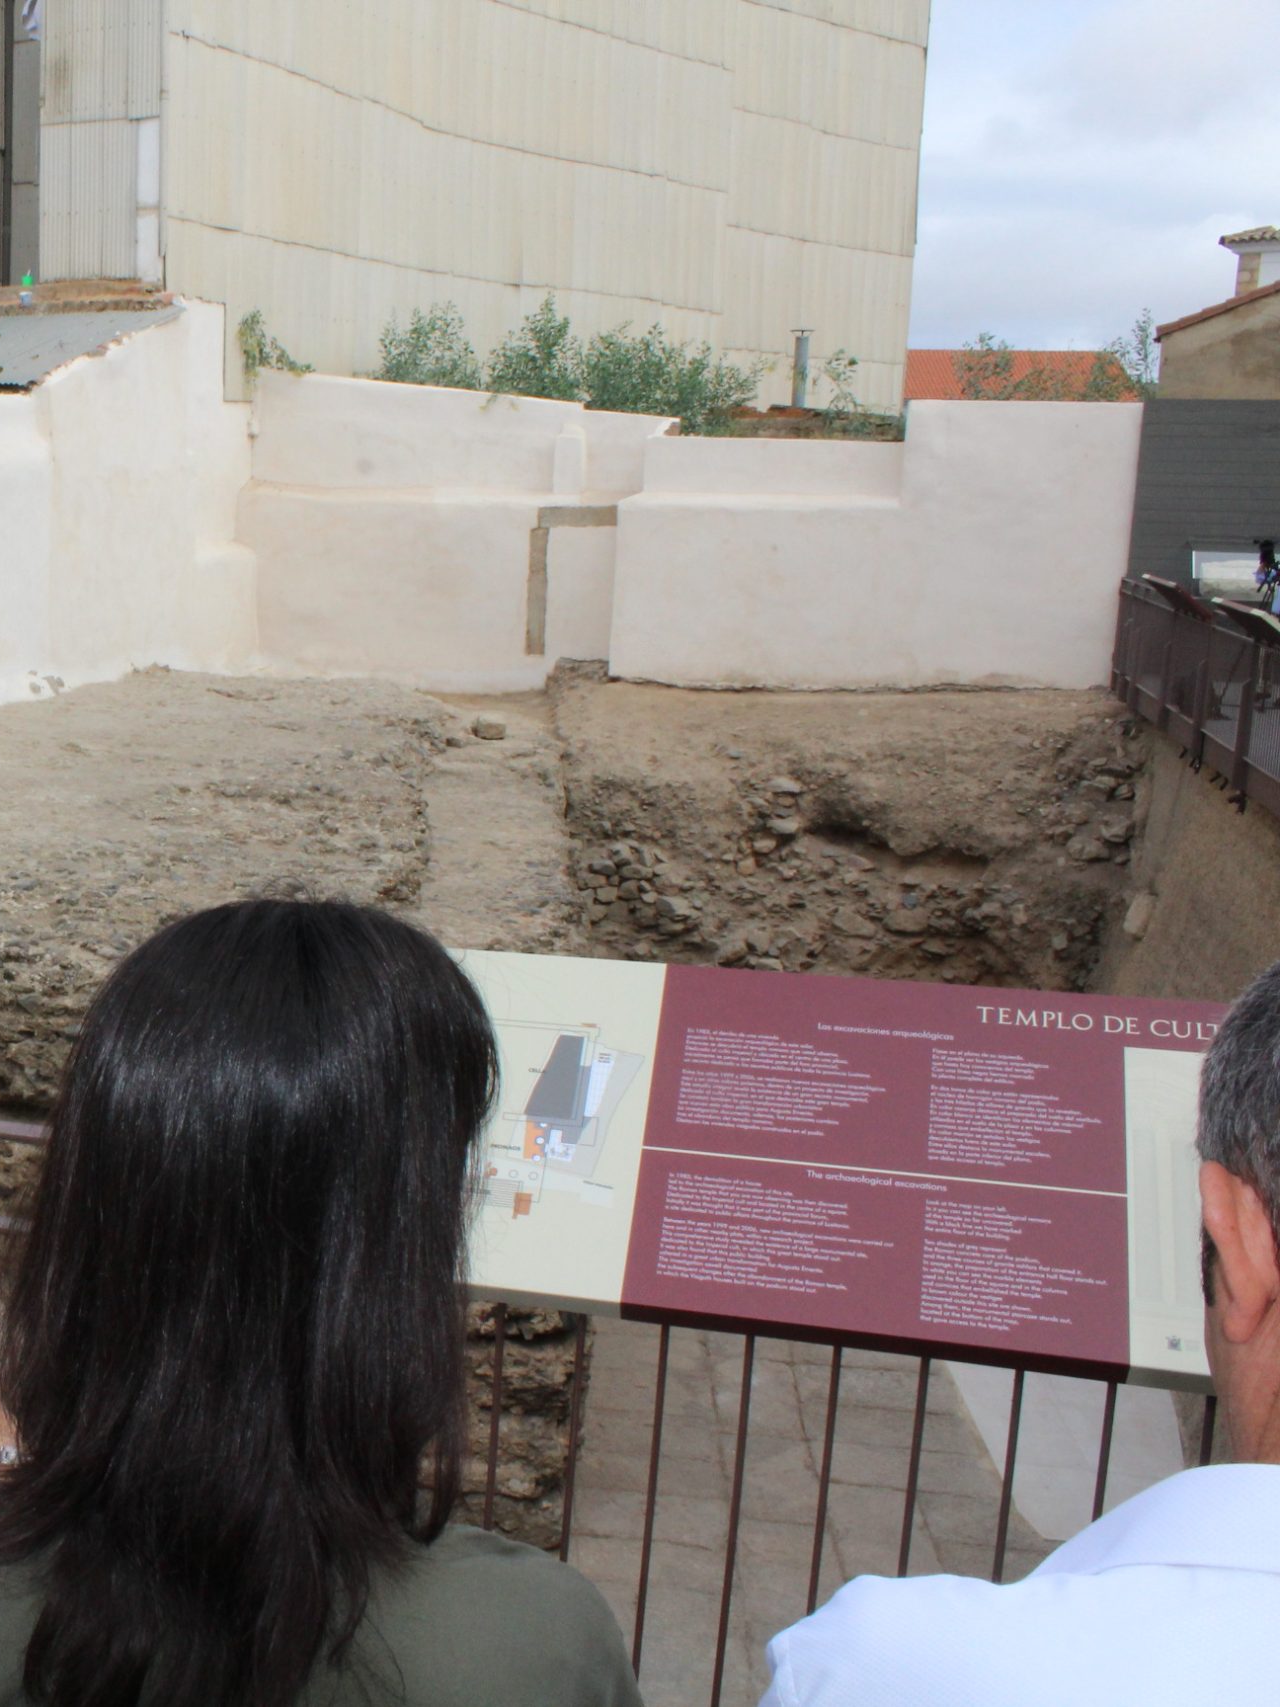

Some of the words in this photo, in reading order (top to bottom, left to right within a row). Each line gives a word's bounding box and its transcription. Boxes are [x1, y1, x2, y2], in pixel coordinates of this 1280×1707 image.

[818, 1022, 832, 1031] Las
[834, 1025, 890, 1036] excavaciones
[892, 1030, 954, 1041] arqueológicas
[976, 1006, 1093, 1030] TEMPLO
[1104, 1015, 1140, 1035] DE
[806, 1169, 823, 1179] The
[825, 1173, 892, 1187] archaeological
[895, 1180, 948, 1192] excavations
